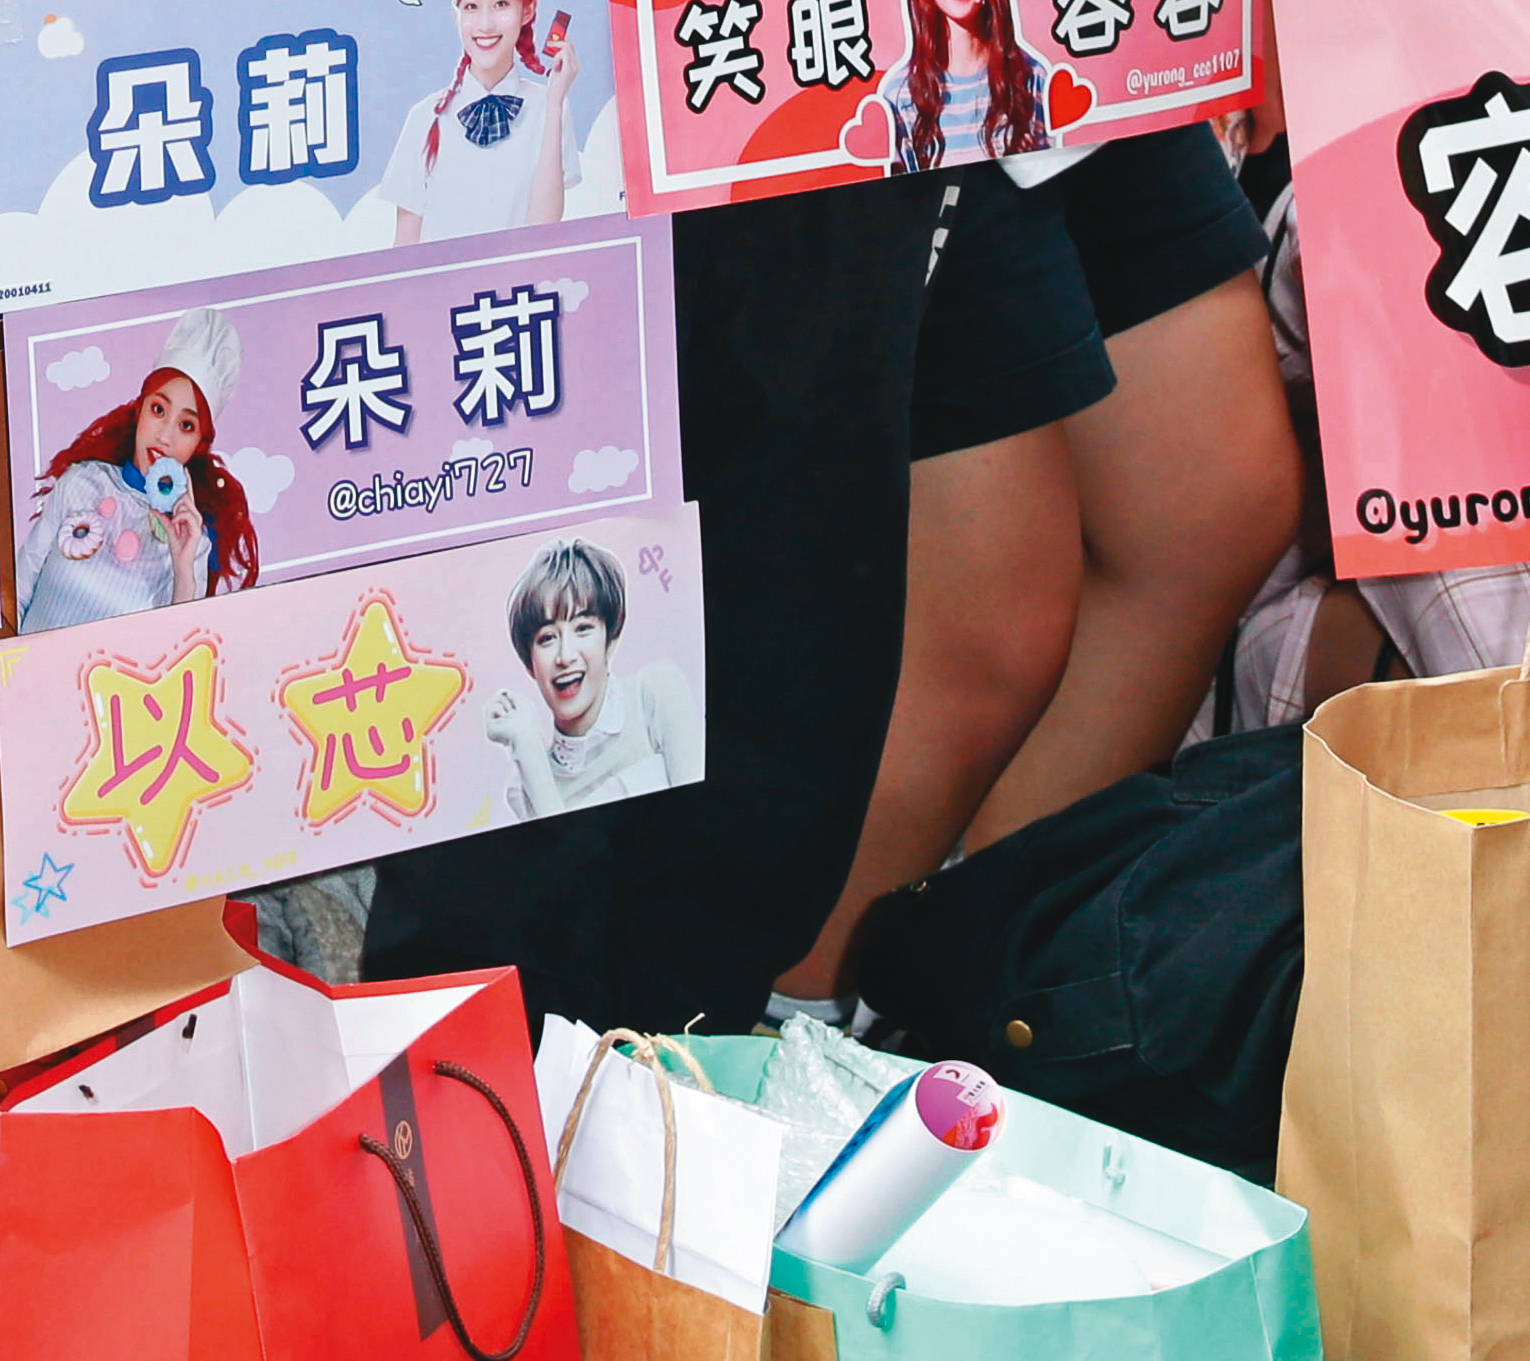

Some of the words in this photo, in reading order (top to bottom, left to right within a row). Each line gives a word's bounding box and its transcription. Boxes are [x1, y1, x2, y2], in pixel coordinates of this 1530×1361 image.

[93, 36, 356, 205] 朵莉
[299, 283, 566, 455] 朵莉
[327, 445, 535, 525] @chiayi727
[96, 663, 413, 807] 以芯
